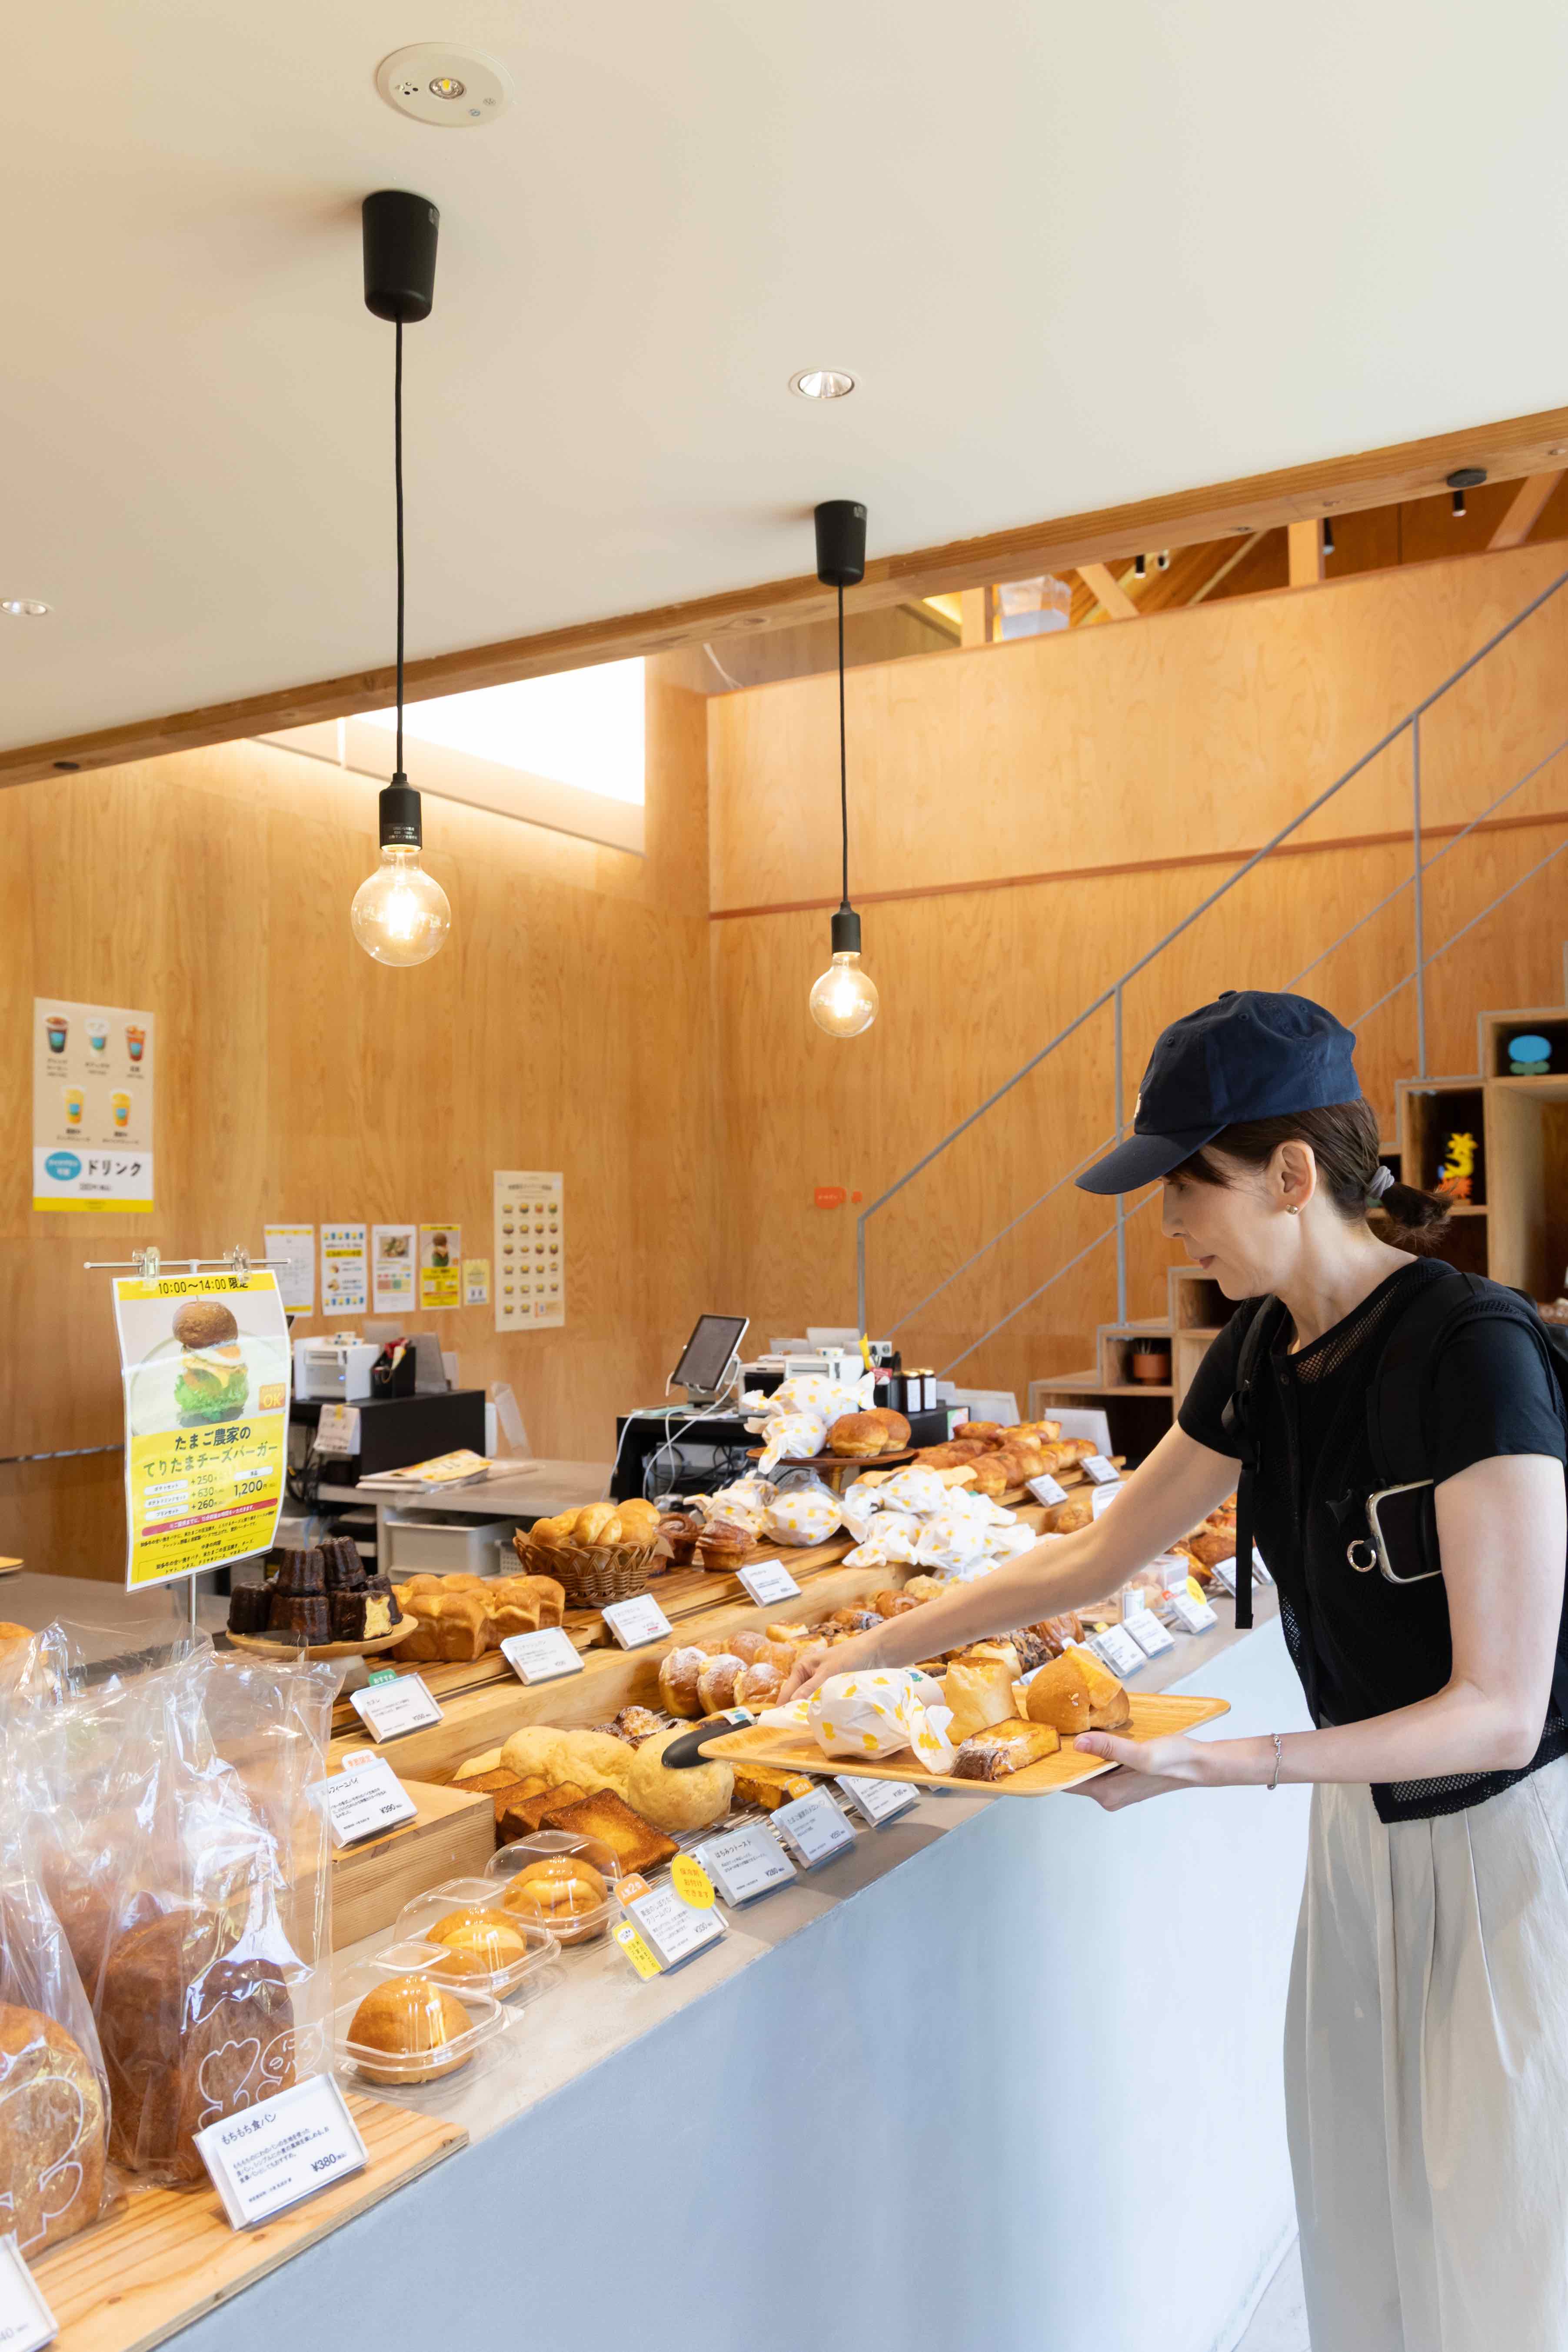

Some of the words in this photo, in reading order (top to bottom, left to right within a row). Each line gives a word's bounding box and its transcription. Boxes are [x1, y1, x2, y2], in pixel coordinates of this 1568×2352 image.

[88, 1159, 141, 1177] ドリンク
[263, 1393, 283, 1409] OK
[174, 1426, 251, 1451] たまご農家の
[143, 1440, 278, 1478] てりたまチーズバーガー
[715, 1839, 752, 1858] はちみつトースト
[679, 1868, 699, 1877] 保冷剤
[685, 1878, 703, 1887] お付け
[683, 1889, 709, 1899] できます
[647, 1907, 671, 1924] クリームパン
[221, 2112, 276, 2145] もちもち食パン
[310, 2153, 336, 2173] ¥380
